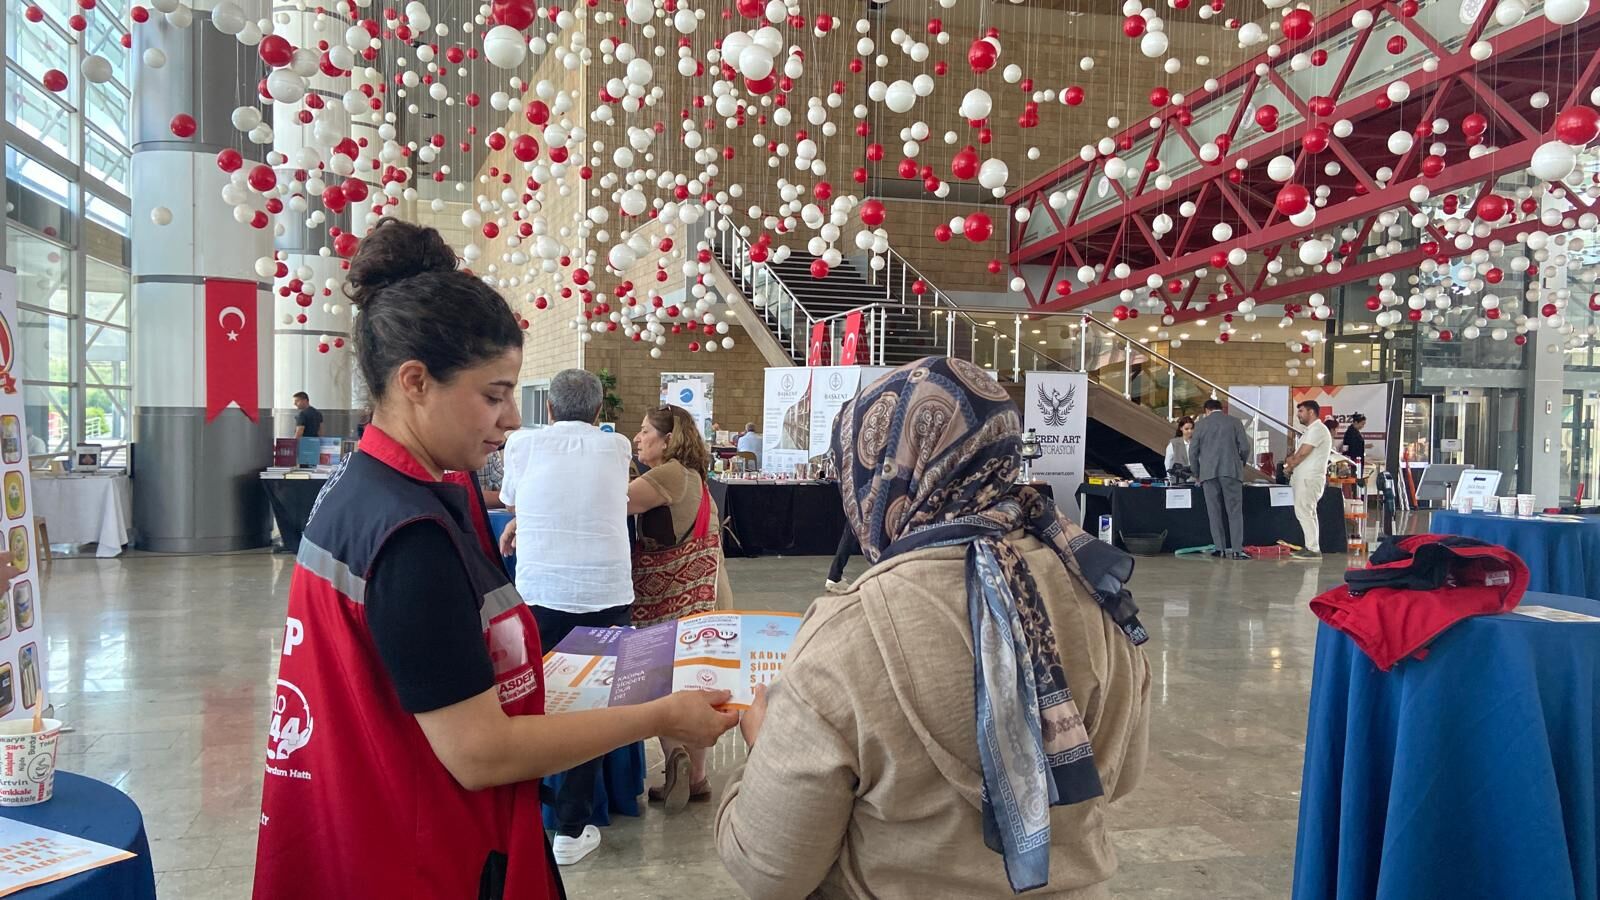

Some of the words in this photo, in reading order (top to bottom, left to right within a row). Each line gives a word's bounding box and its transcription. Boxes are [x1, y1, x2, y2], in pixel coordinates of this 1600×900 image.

[1035, 435, 1059, 444] EREN
[1062, 435, 1081, 444] ART
[499, 671, 533, 694] ASDEP
[269, 714, 300, 745] 44
